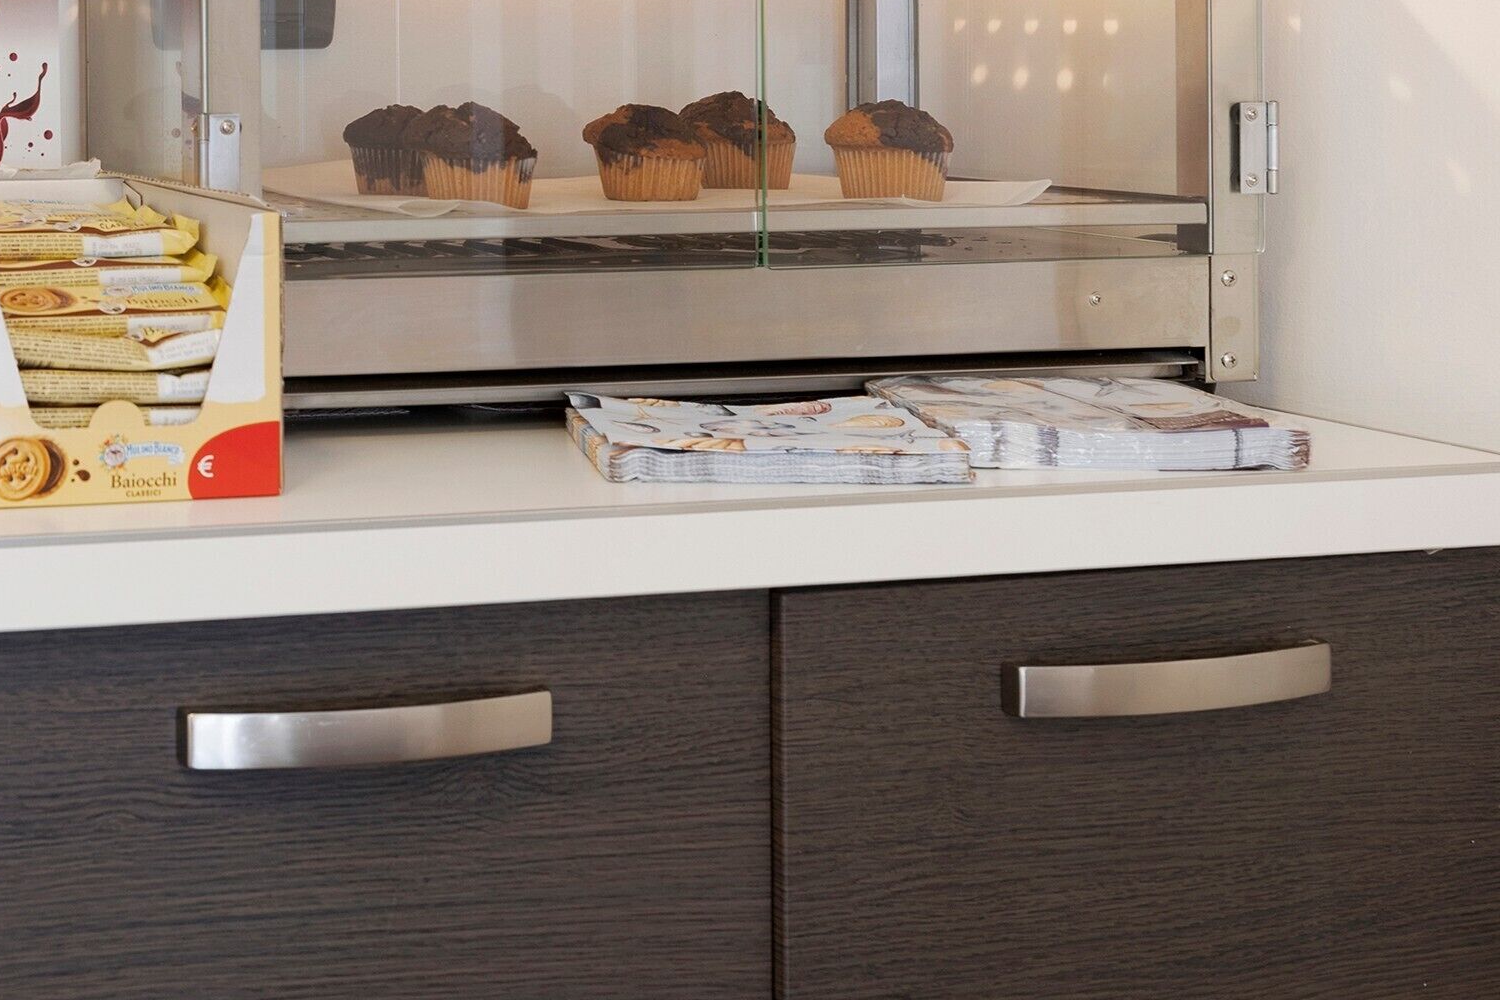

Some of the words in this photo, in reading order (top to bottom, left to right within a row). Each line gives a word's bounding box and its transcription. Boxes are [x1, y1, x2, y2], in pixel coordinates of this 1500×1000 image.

[197, 455, 215, 478] €
[110, 471, 177, 489] Baiocchi
[125, 489, 162, 498] CLASSICI
